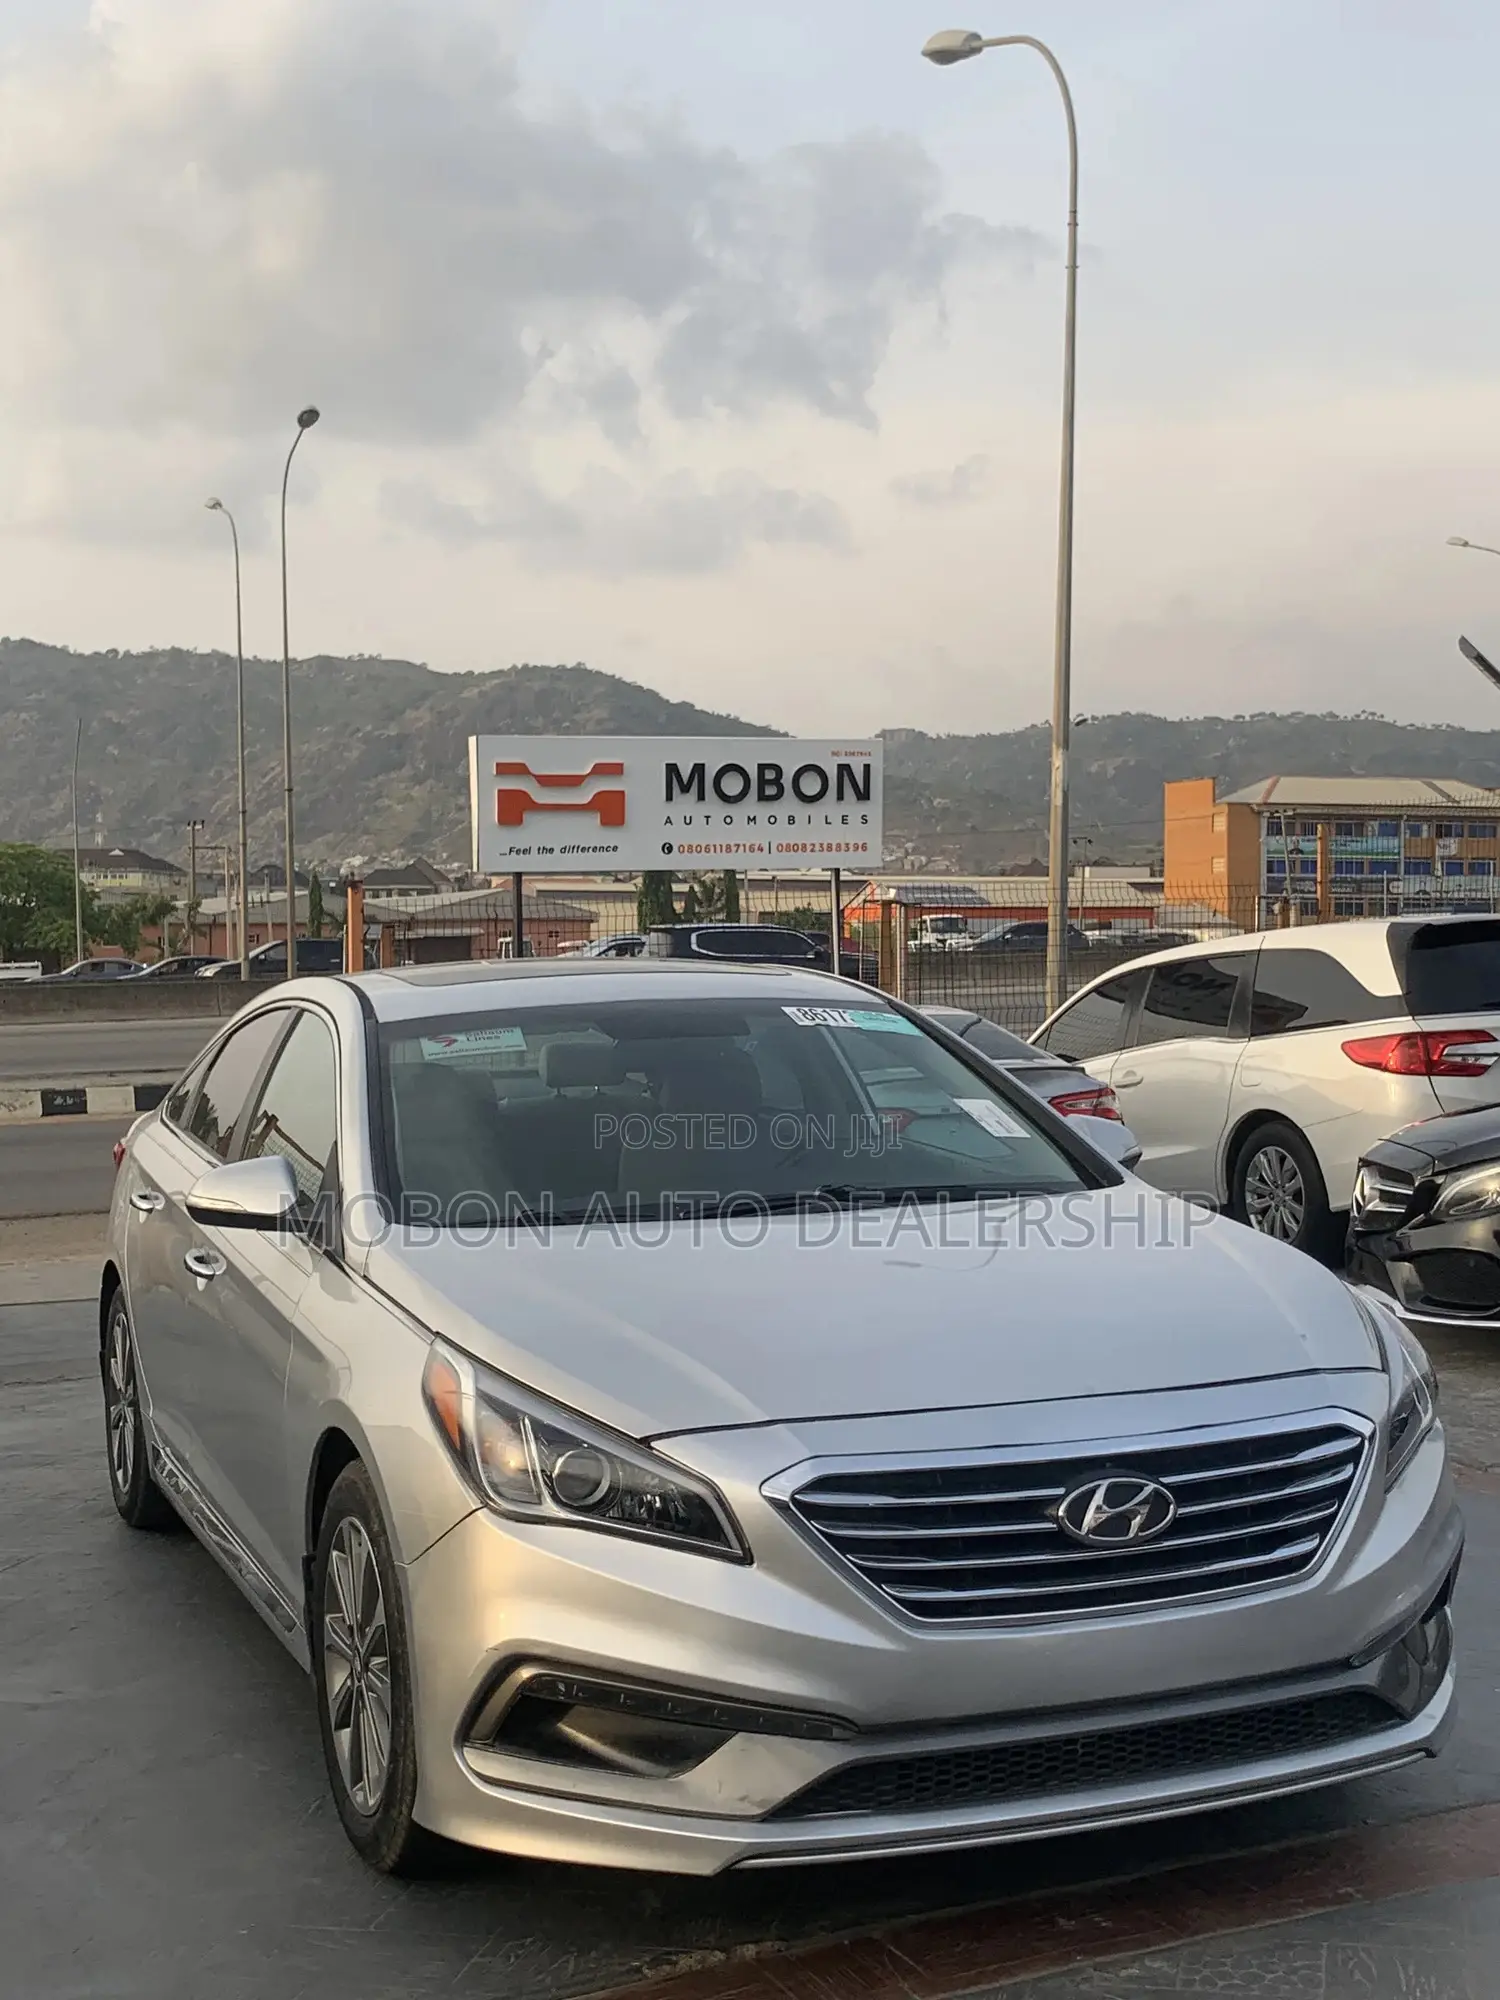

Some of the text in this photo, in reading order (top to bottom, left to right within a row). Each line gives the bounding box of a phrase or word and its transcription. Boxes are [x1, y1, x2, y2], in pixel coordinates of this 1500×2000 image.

[664, 762, 871, 804] MOBON
[664, 815, 869, 826] AUTOMOBILES
[537, 845, 555, 855] the
[559, 844, 619, 855] difference
[677, 843, 764, 854] 08061187164
[776, 842, 868, 853] 08082388396
